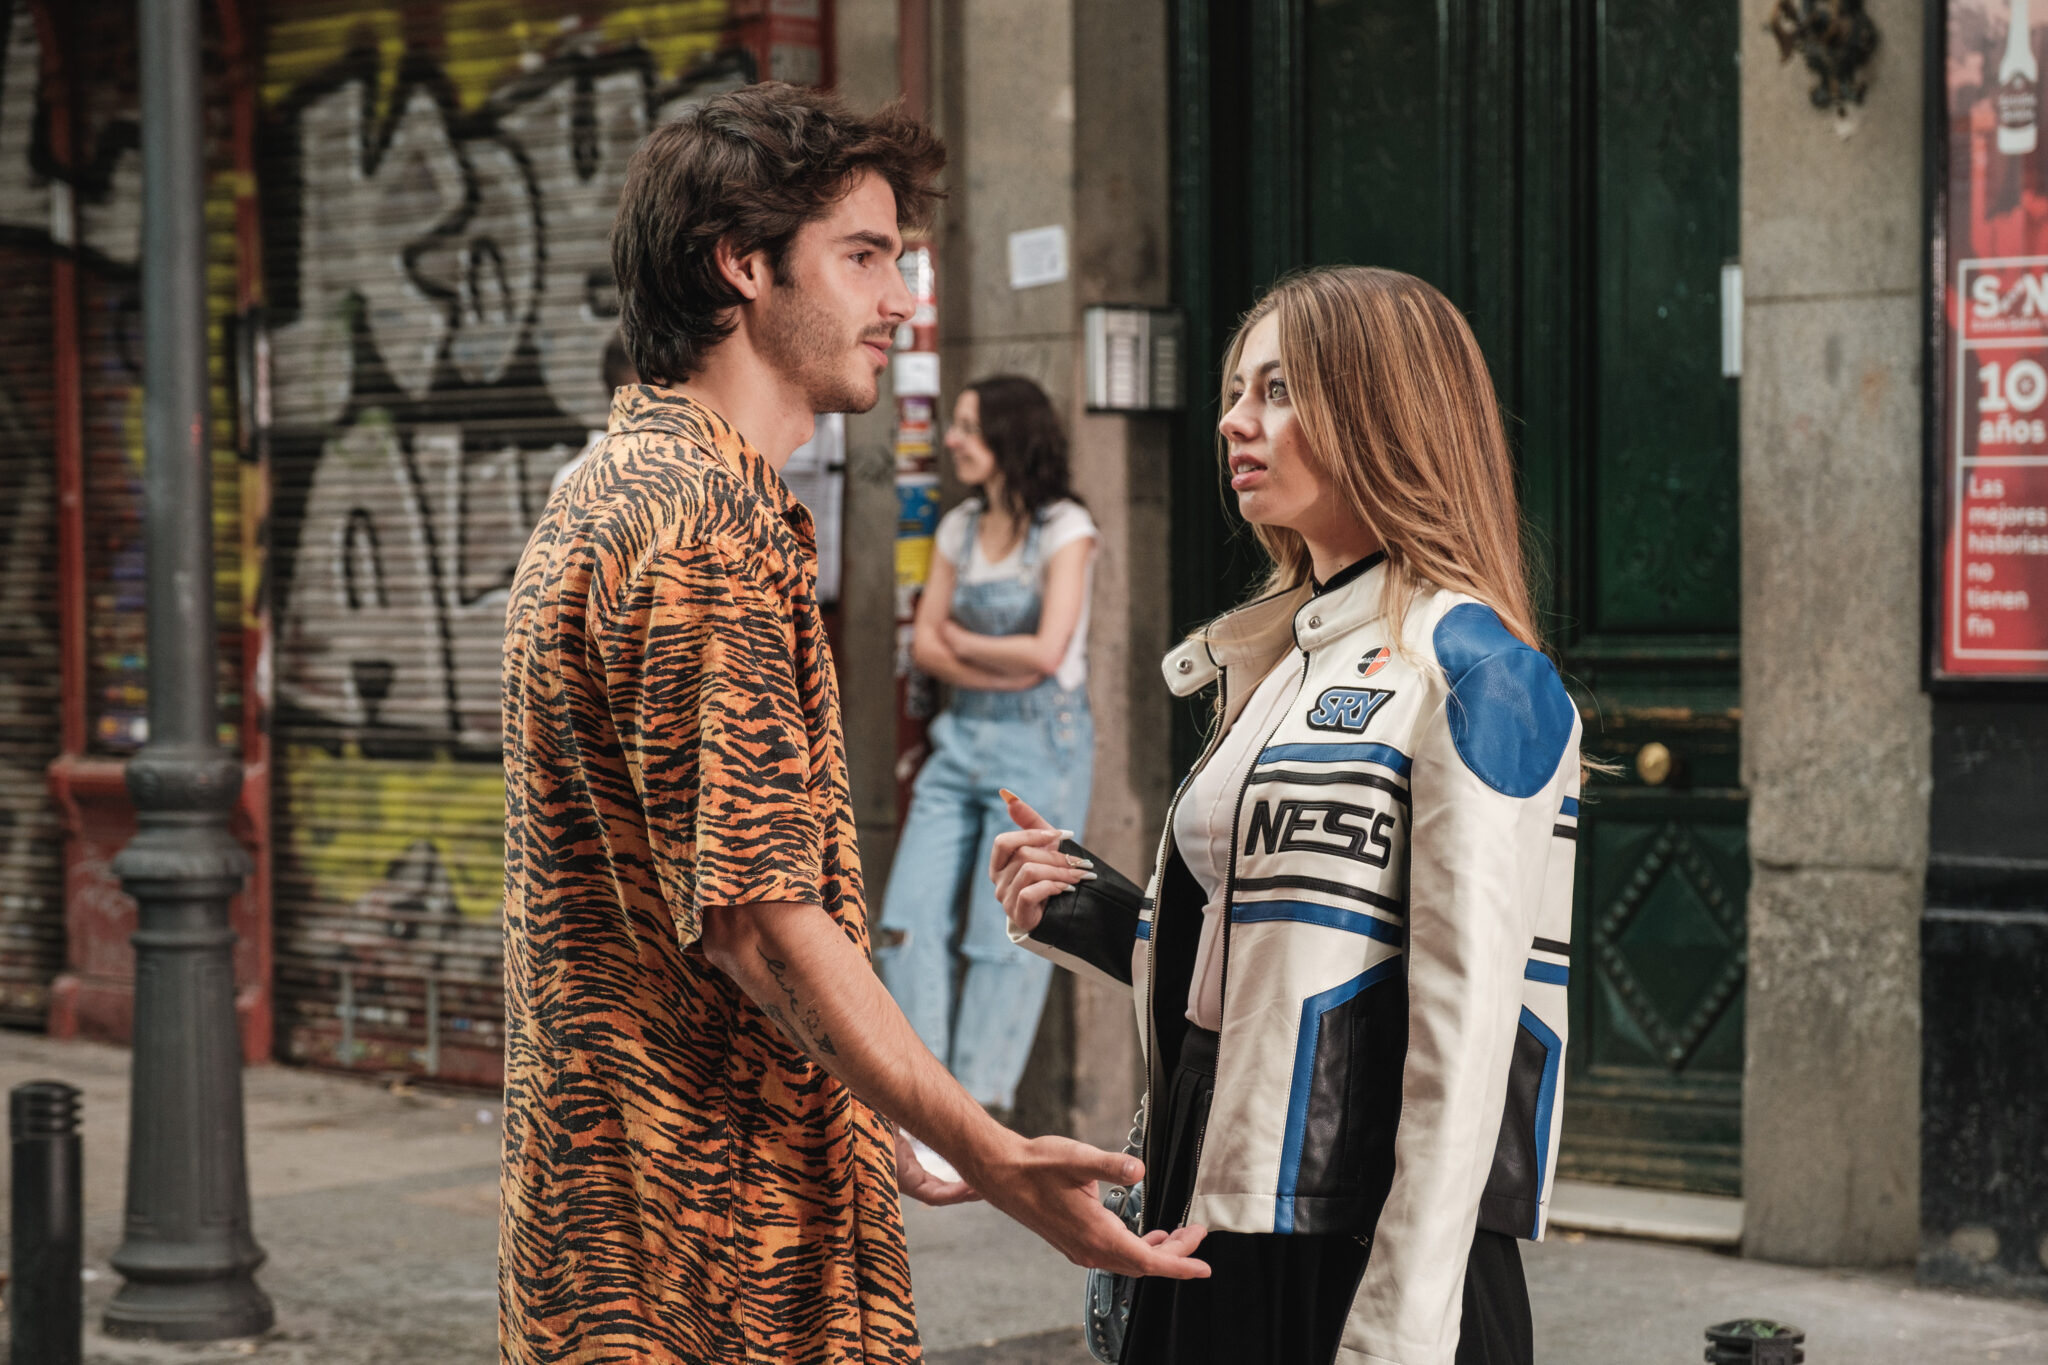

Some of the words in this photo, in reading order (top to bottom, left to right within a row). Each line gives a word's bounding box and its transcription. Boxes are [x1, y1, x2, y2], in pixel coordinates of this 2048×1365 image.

[1979, 361, 2047, 412] 10
[1979, 414, 2046, 443] años
[1969, 474, 2005, 499] Las
[1968, 502, 2048, 531] mejores
[1968, 530, 2048, 554] historias
[1967, 562, 1994, 582] no
[1967, 586, 2029, 610] tienen
[1967, 613, 1995, 637] fin
[1308, 687, 1393, 732] SRY
[1244, 800, 1396, 870] NESS
